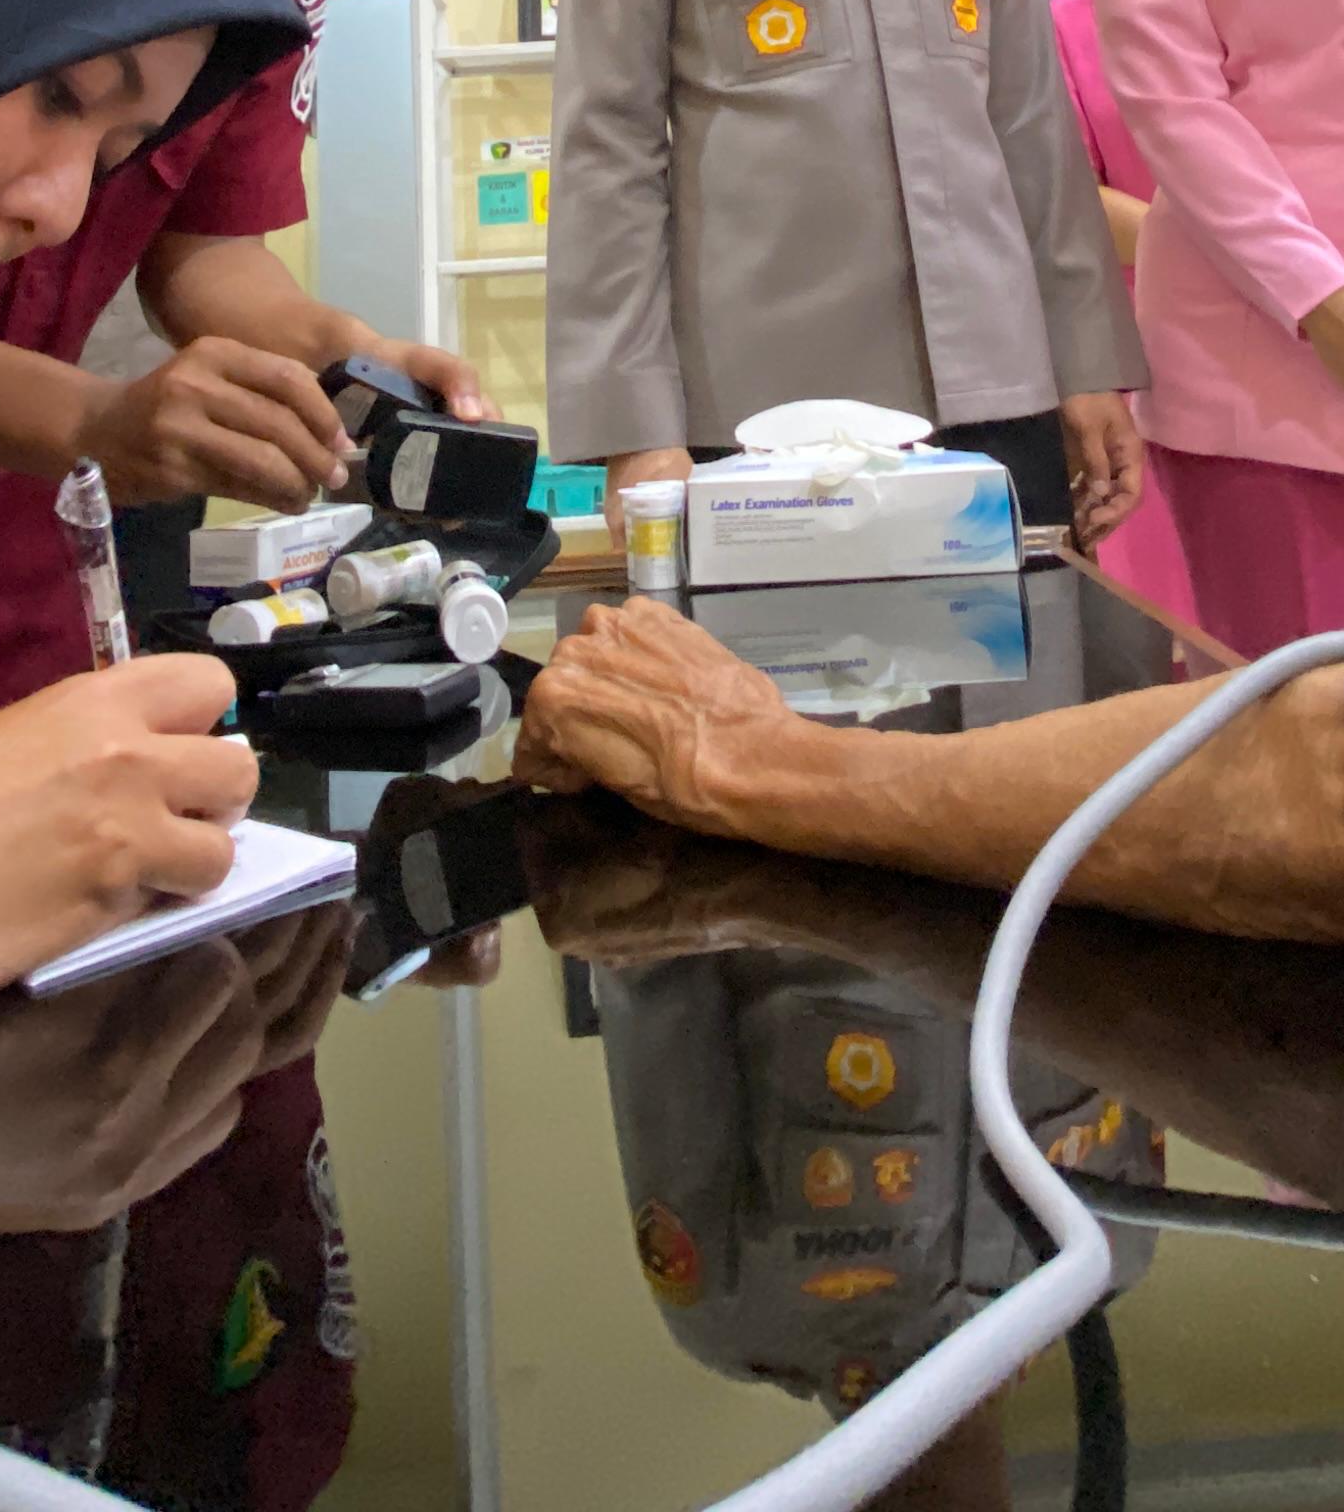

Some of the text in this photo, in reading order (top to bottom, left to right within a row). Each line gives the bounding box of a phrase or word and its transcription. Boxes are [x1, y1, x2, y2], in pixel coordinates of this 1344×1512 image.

[710, 495, 854, 511] Latex Examination Gloves
